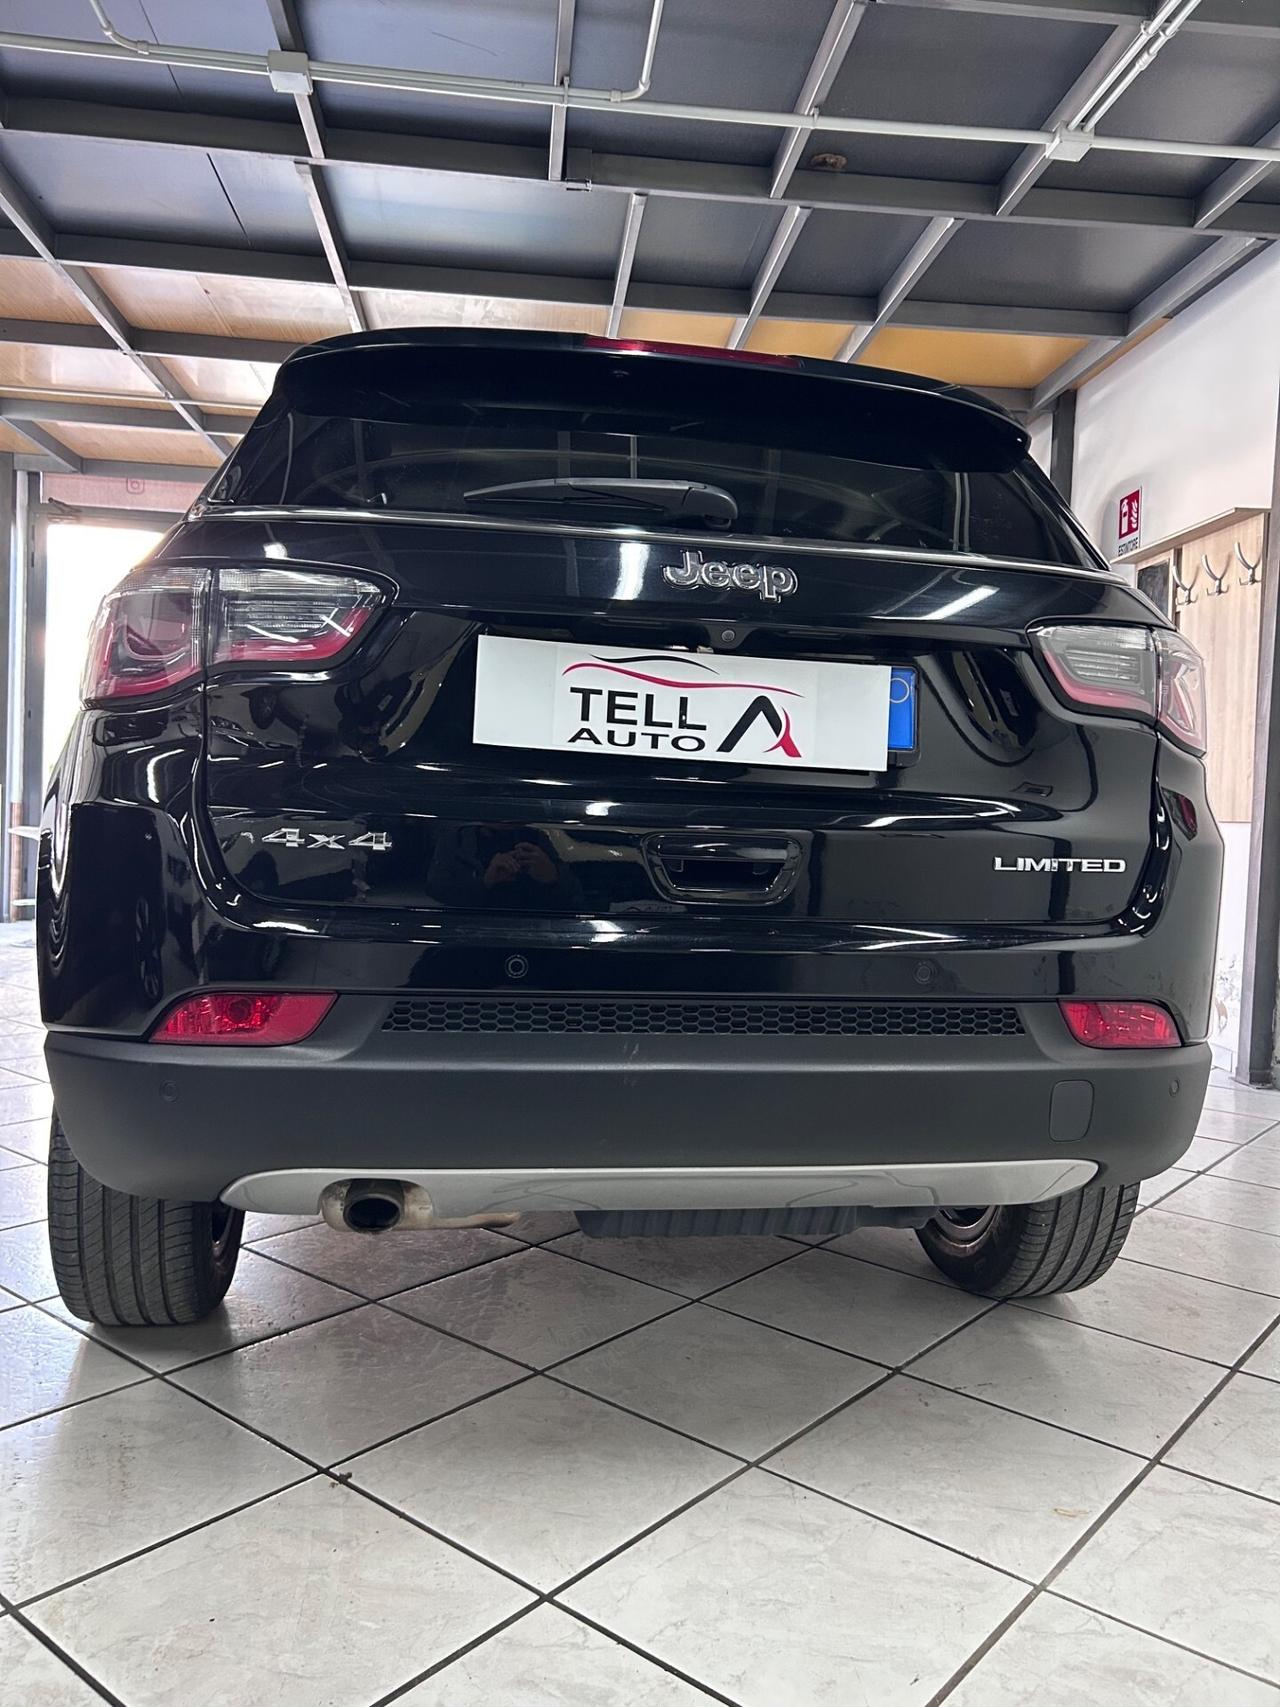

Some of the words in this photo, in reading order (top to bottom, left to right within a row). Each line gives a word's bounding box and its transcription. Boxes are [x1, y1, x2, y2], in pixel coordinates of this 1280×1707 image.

[662, 550, 798, 602] Jeep
[569, 686, 707, 730] TELL
[567, 728, 706, 751] AUTO
[261, 827, 392, 851] 4x4
[993, 856, 1127, 873] LIMITED
